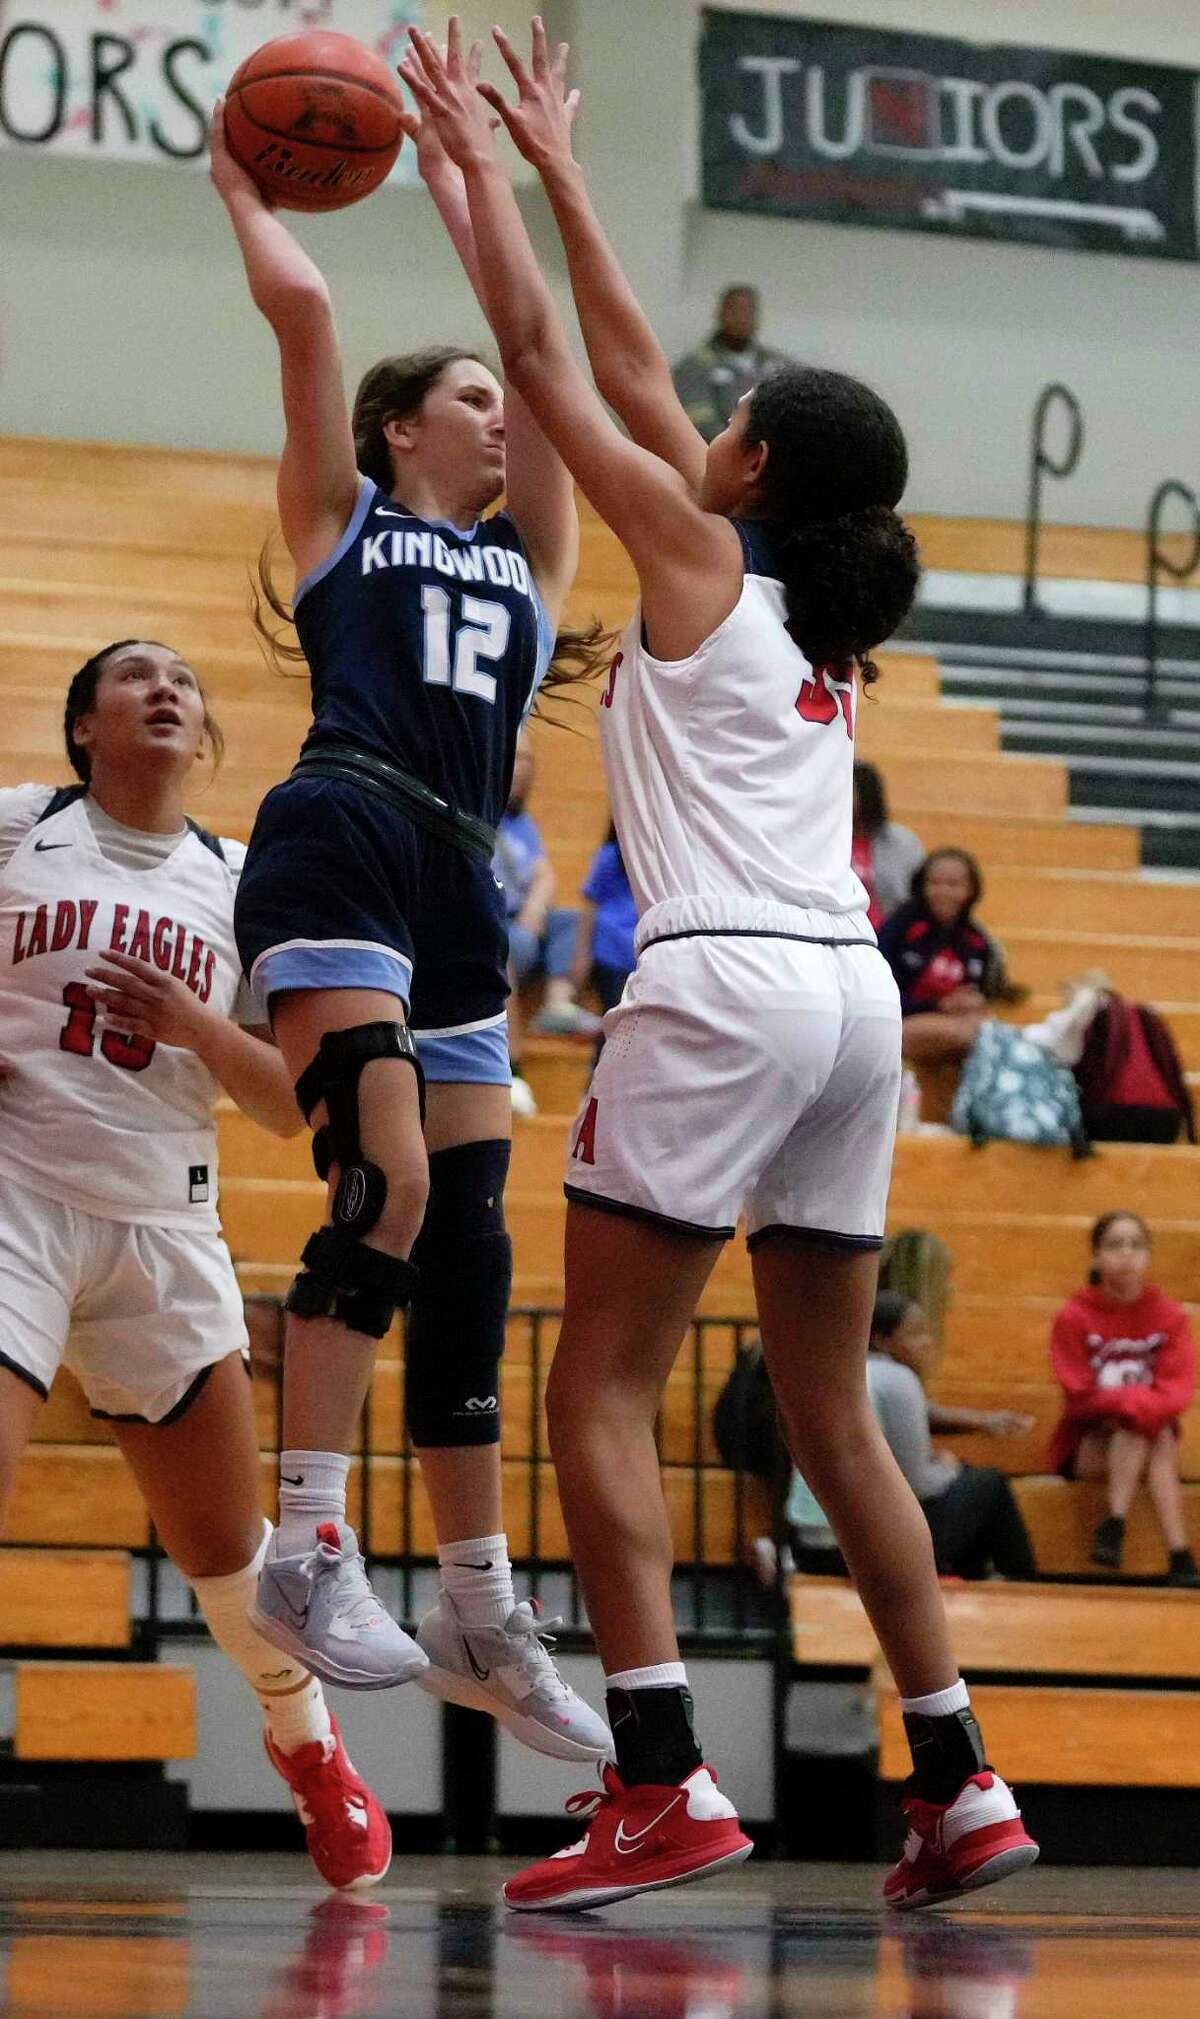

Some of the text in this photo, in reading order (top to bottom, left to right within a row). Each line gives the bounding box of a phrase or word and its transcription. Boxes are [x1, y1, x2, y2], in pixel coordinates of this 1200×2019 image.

[728, 55, 1163, 182] JUNIORS
[420, 584, 512, 704] 12
[12, 899, 218, 1005] LADY EAGLES
